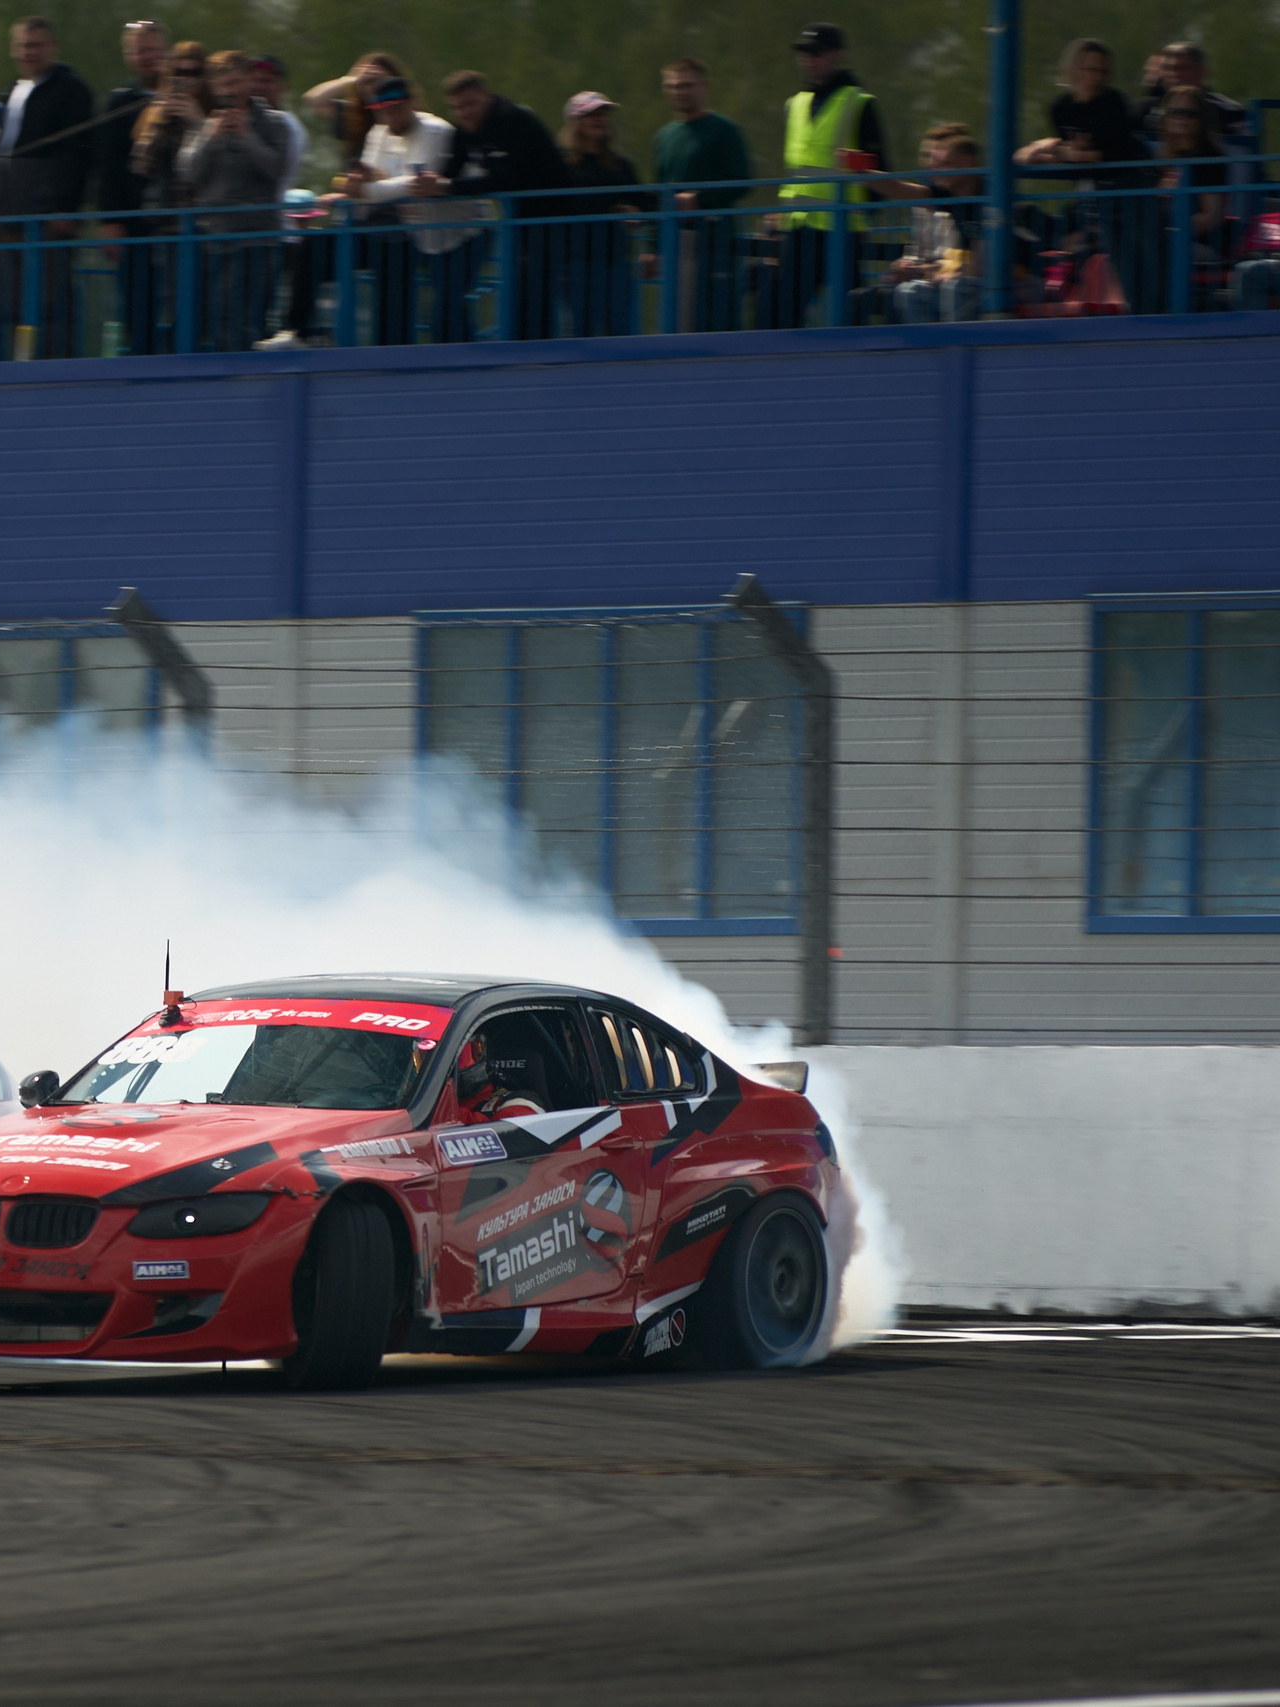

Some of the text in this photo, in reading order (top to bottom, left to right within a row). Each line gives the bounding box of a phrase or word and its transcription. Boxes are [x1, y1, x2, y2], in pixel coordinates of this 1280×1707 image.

[222, 1009, 281, 1021] RDS
[350, 1012, 431, 1031] PRO
[97, 1035, 209, 1065] 888
[444, 1135, 501, 1158] AIMOL
[477, 1179, 576, 1242] КУЛЬТУРА ЗАНОСА
[479, 1210, 576, 1288] Tamashi
[136, 1264, 186, 1276] AIMOL
[536, 1257, 577, 1287] technology
